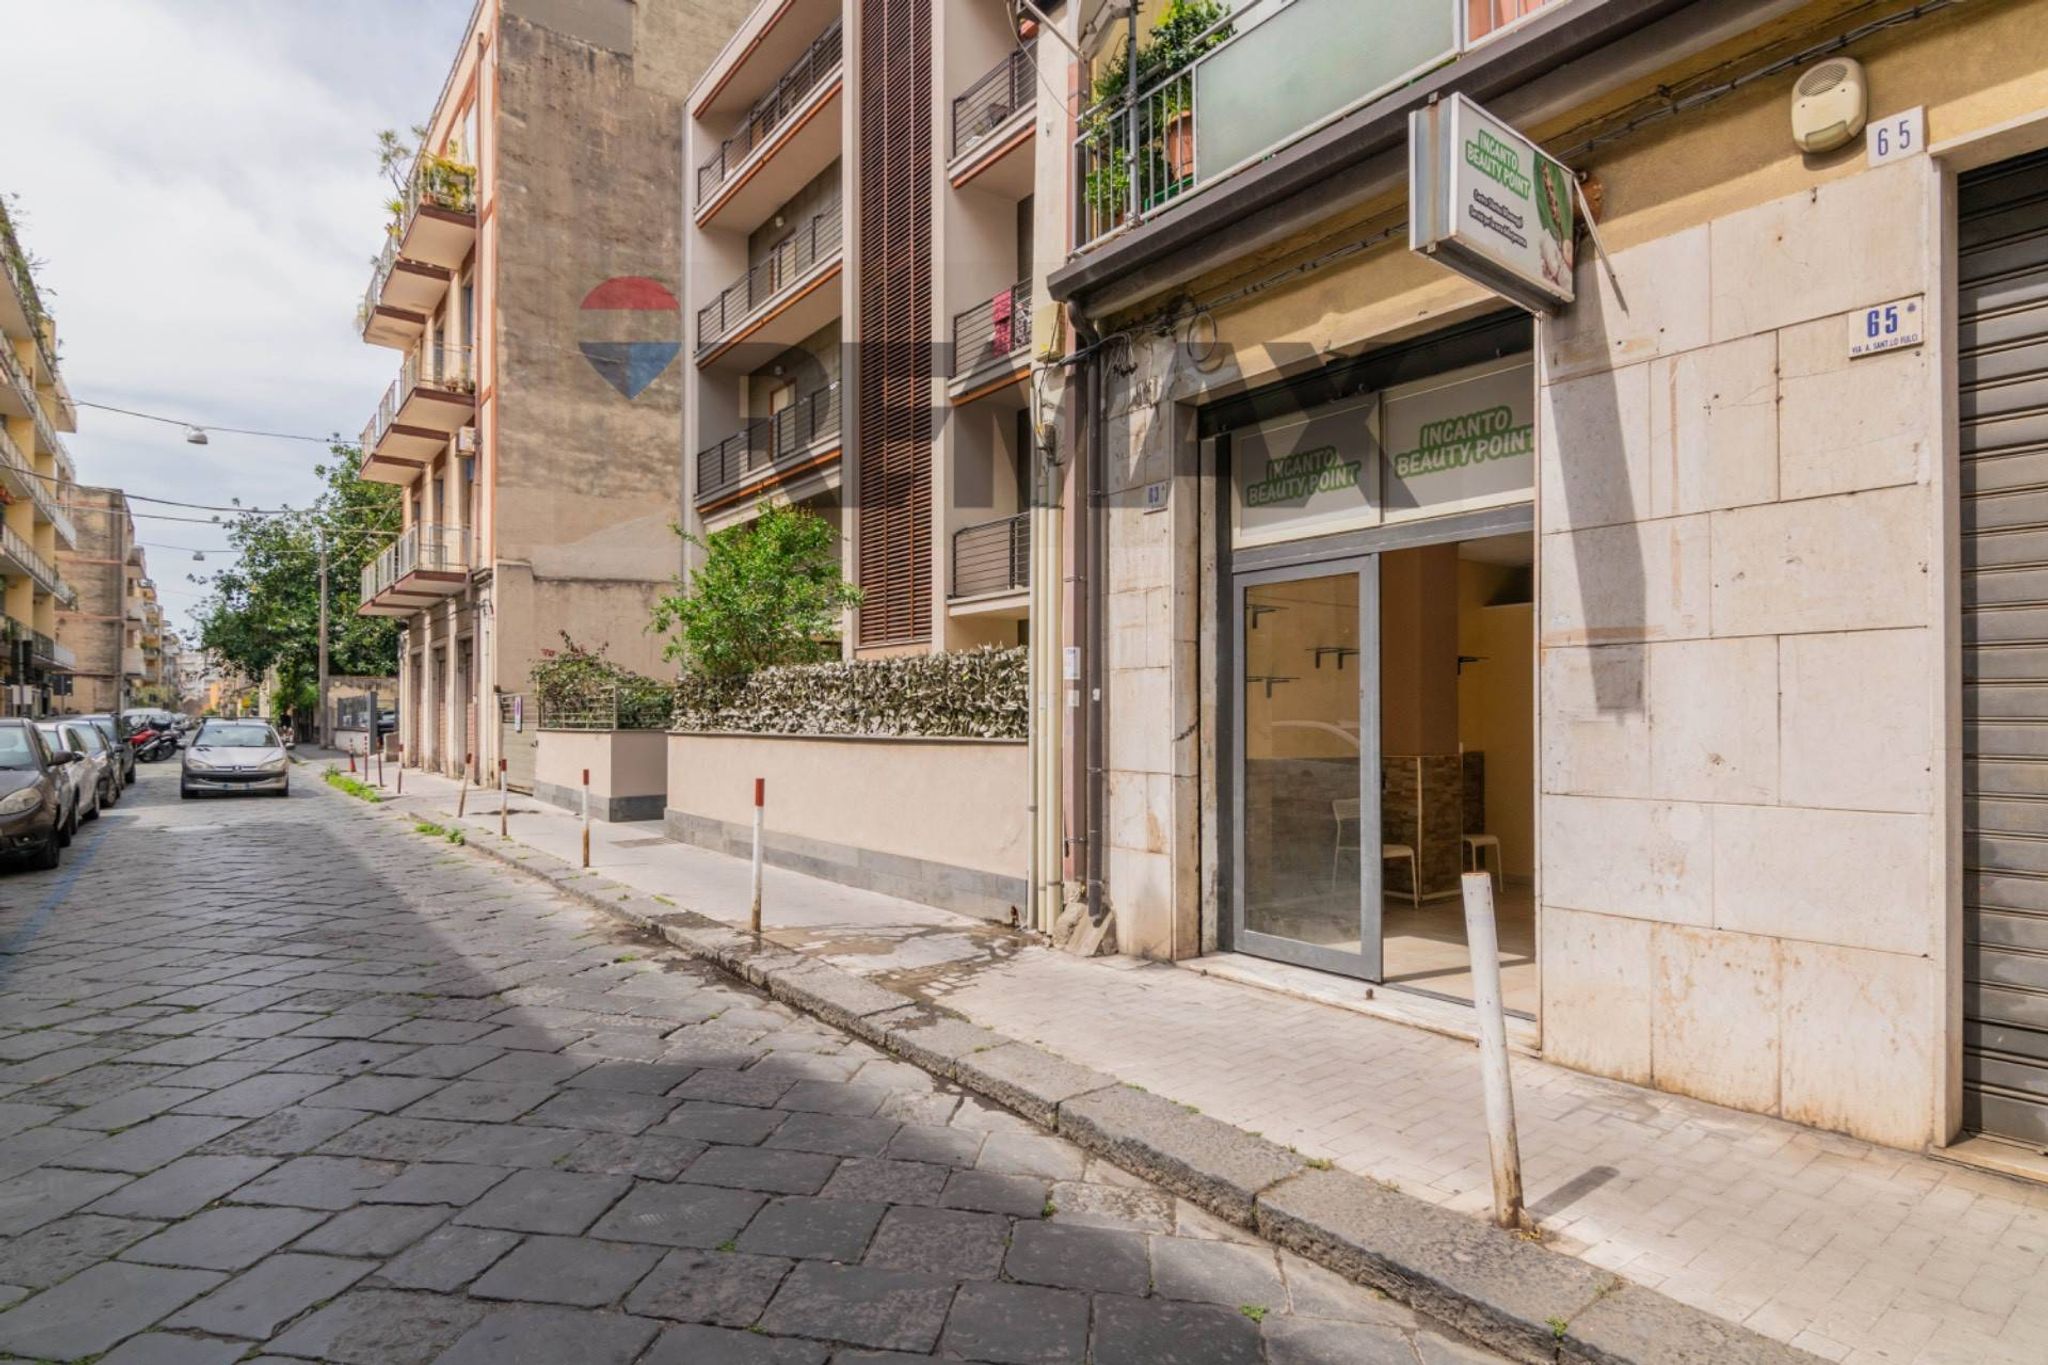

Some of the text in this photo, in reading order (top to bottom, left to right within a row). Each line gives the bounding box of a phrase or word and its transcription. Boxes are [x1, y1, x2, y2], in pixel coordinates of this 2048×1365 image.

[1479, 131, 1518, 168] INCANTO
[1877, 120, 1911, 157] 65
[1467, 143, 1530, 198] BEAUTY POINT
[1867, 306, 1897, 337] 65
[1422, 410, 1509, 447] INCANTO
[1267, 449, 1336, 479] INCANTO
[1397, 443, 1473, 475] BEAUTY
[1249, 466, 1358, 503] BEAUTY POINT
